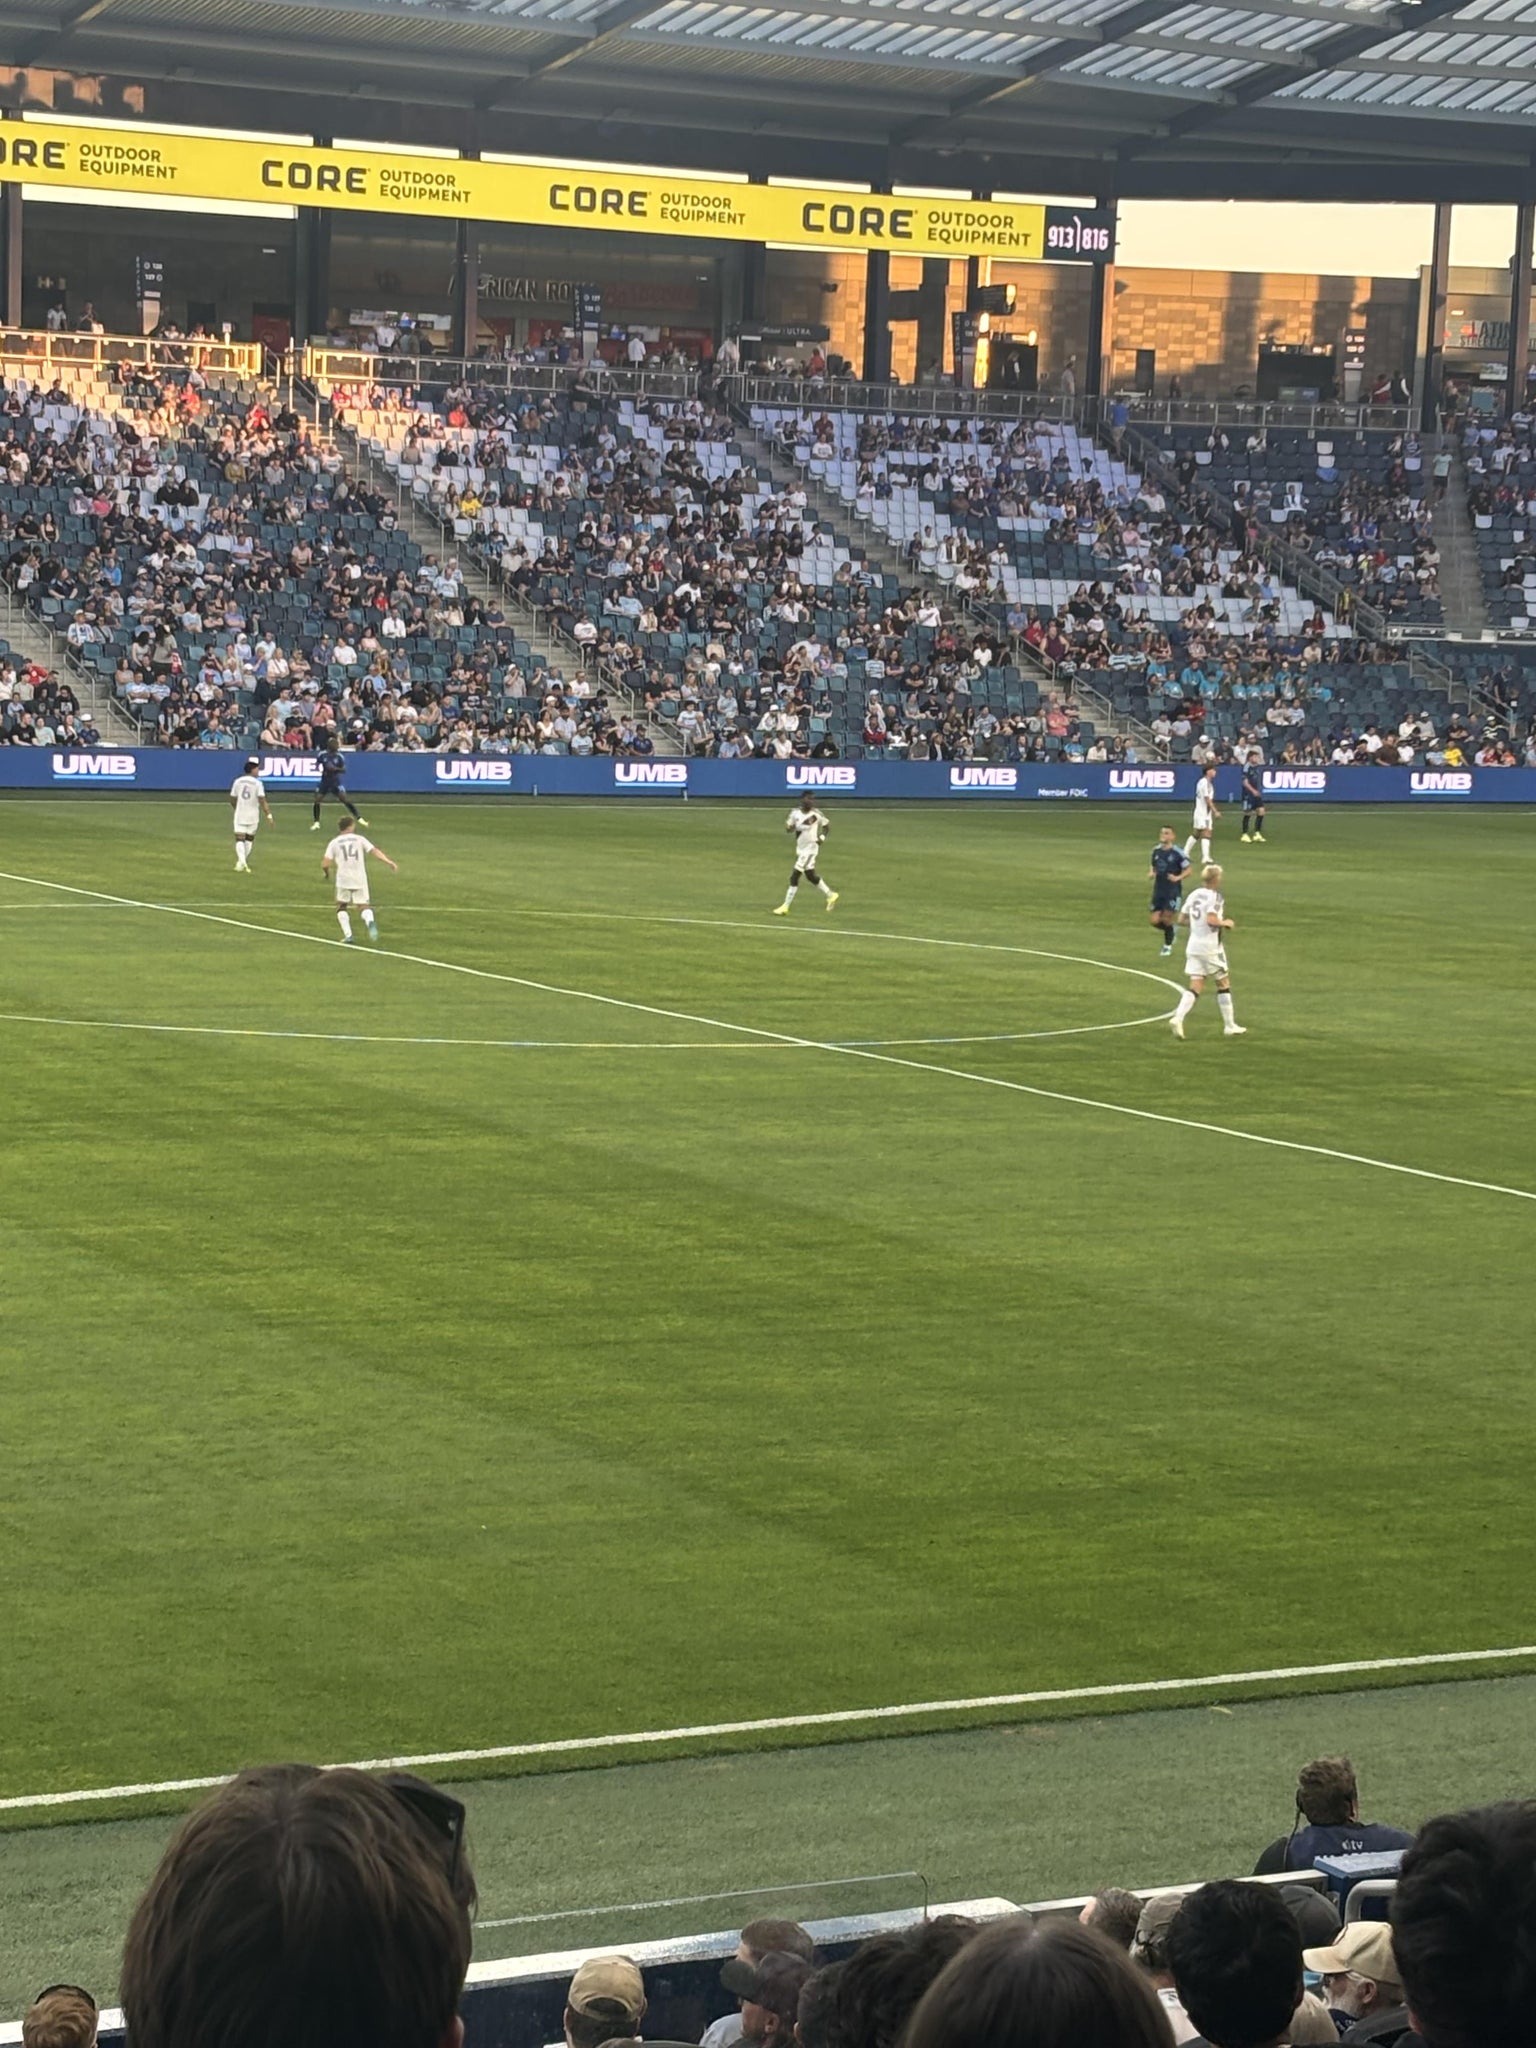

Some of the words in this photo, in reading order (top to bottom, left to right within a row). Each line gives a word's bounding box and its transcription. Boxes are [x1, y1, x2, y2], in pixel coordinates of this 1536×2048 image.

[79, 144, 162, 162] OUTDOOR
[79, 160, 178, 179] EQUIPMENT
[262, 160, 367, 194] CORE
[380, 169, 456, 187] OUTDOOR
[380, 185, 471, 203] EQUIPMENT
[549, 184, 648, 217] CORE
[660, 193, 732, 209] OUTDOOR
[660, 207, 746, 225] EQUIPMENT
[802, 202, 913, 239] CORE
[928, 211, 1014, 229] OUTDOOR
[928, 228, 1031, 246] EQUIPMENT
[786, 328, 811, 336] ULTRA
[53, 754, 136, 774] UMB
[437, 761, 512, 780] UMB
[615, 763, 687, 782] UMB
[787, 766, 856, 785] UMB
[951, 768, 1017, 786] UMB
[1110, 770, 1175, 788] UMB
[1262, 771, 1326, 789] UMB
[1410, 772, 1472, 790] UMB
[241, 785, 251, 800] 6
[1037, 788, 1068, 797] Member
[1069, 788, 1088, 797] FDIC
[339, 843, 359, 862] 14
[1192, 900, 1202, 920] 5
[1351, 1839, 1363, 1850] tv
